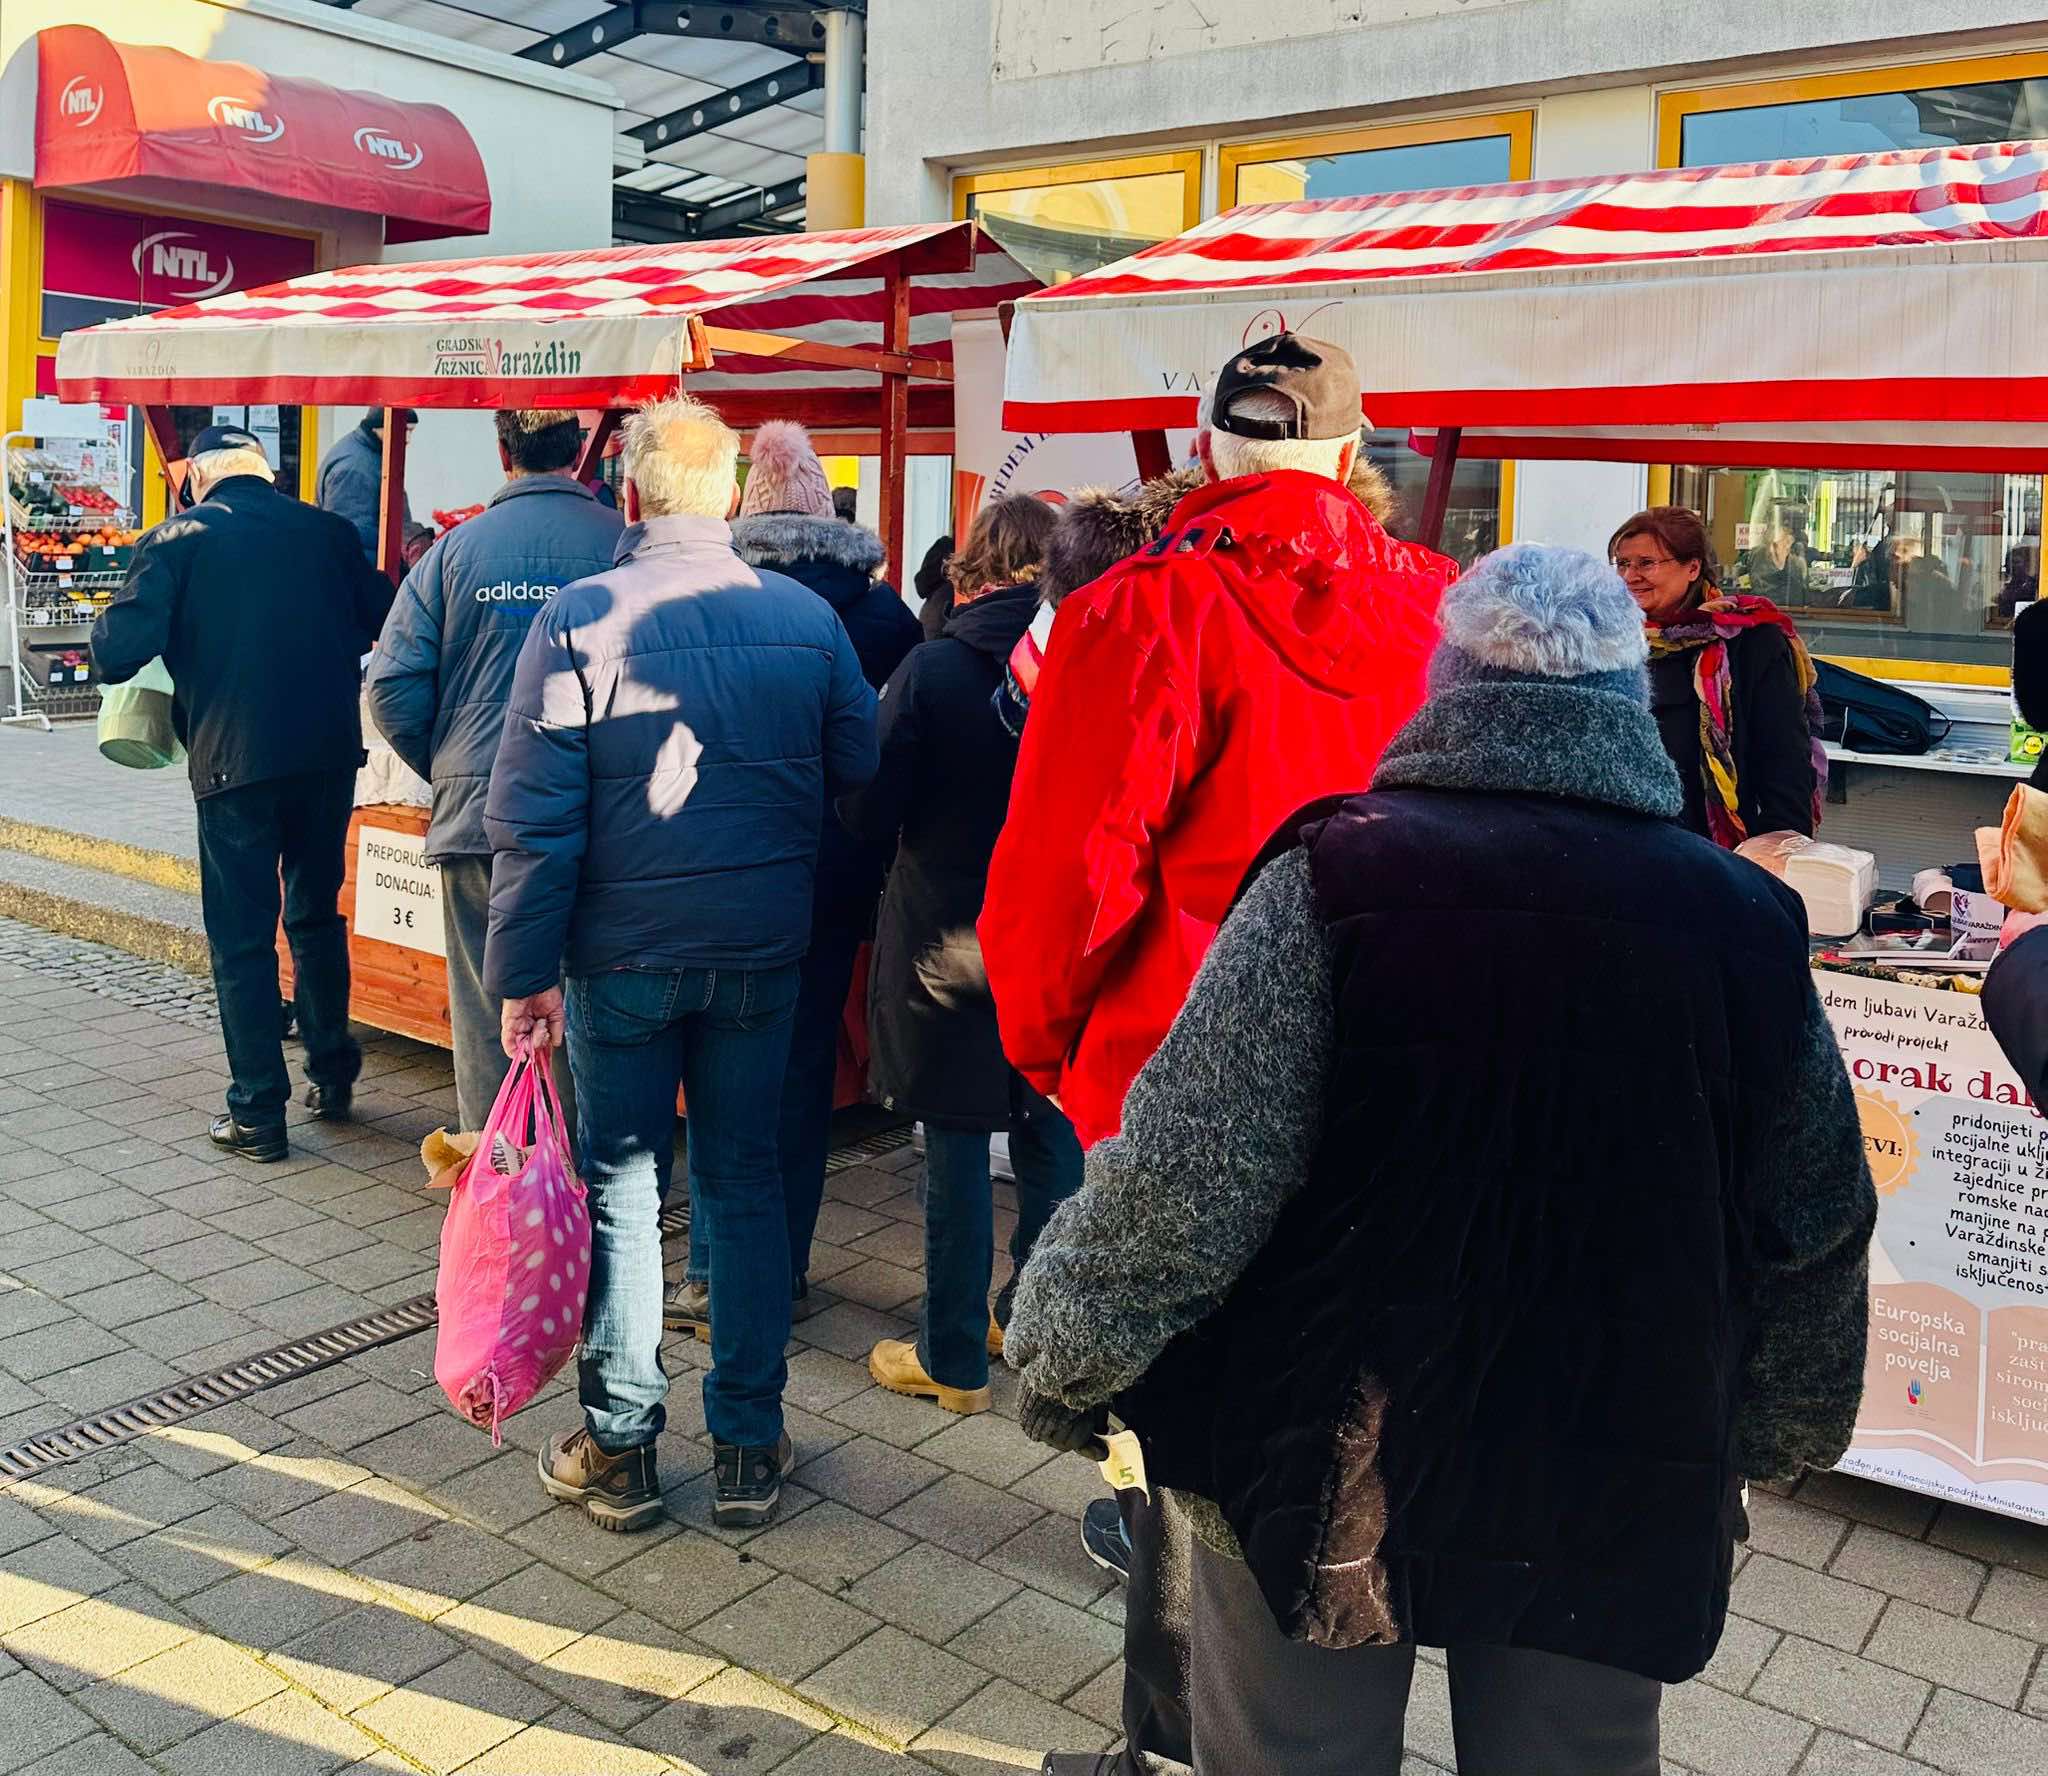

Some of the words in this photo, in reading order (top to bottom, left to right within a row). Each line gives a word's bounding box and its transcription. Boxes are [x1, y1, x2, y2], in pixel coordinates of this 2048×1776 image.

[67, 88, 97, 115] NTL
[220, 102, 273, 134] NTL
[365, 133, 412, 161] NTL
[152, 243, 218, 283] NTL
[484, 338, 581, 375] Varaždin
[475, 580, 560, 602] adidas
[375, 872, 435, 899] DONACIJA:
[393, 907, 401, 925] 3
[405, 910, 415, 928] €
[1864, 997, 1917, 1019] ljubavi
[1844, 1025, 1895, 1042] provodi
[1897, 1033, 1950, 1052] projekt
[1848, 1053, 1952, 1093] orak
[1952, 1113, 2033, 1140] pridonijeti
[1943, 1131, 2010, 1153] socijalne
[1932, 1145, 2011, 1177] integraciji
[2018, 1164, 2028, 1177] u
[1953, 1171, 2025, 1195] zajednice
[1959, 1191, 2018, 1212] romske
[1950, 1208, 2010, 1231] manjine
[2017, 1222, 2036, 1236] na
[1945, 1222, 2046, 1256] Varaždinske
[1967, 1249, 2032, 1274] smanjiti
[1874, 1298, 1966, 1336] Europska
[1878, 1327, 1961, 1358] socijalna
[1884, 1352, 1952, 1383] povelja
[1119, 1466, 1135, 1486] 5
